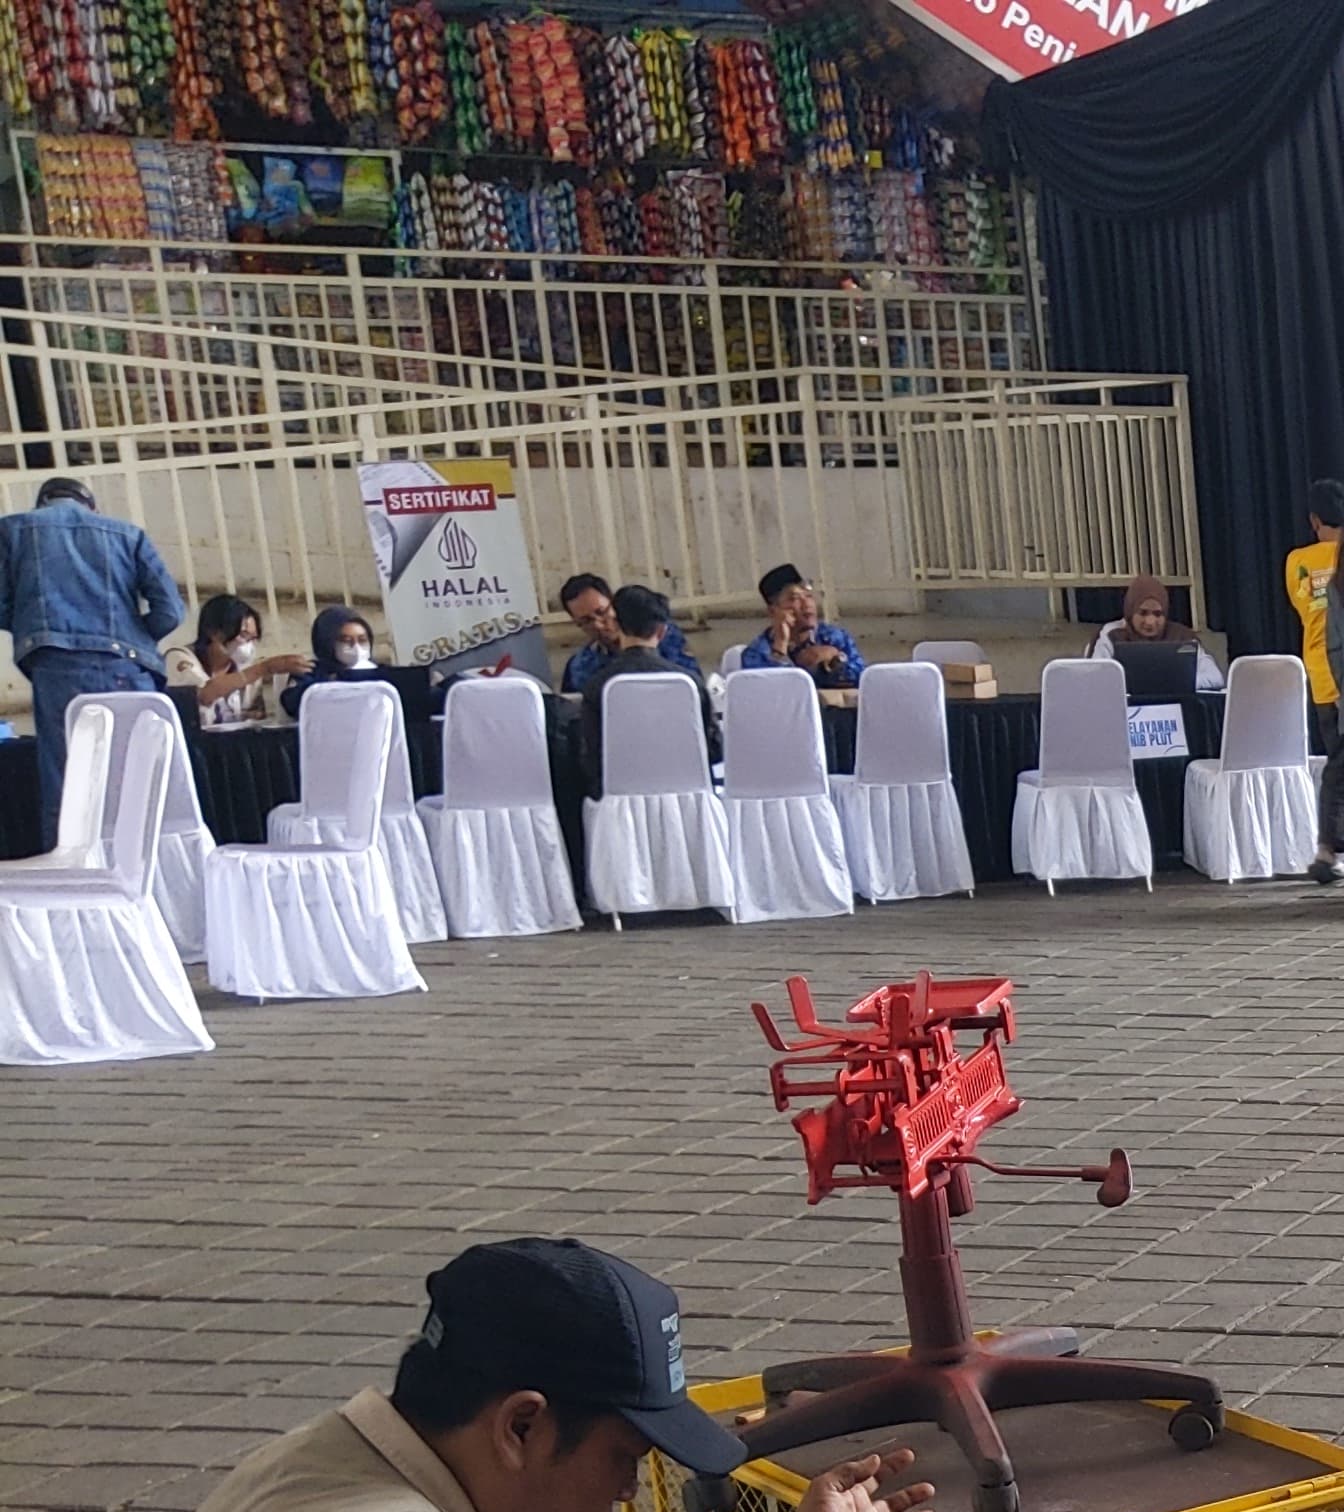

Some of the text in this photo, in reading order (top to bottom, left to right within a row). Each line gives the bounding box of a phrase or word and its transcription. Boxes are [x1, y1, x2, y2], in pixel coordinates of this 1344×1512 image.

[389, 489, 490, 510] SERTIFIKAT
[421, 575, 508, 598] HALAL
[424, 597, 512, 609] INDONESIA
[1129, 720, 1176, 734] ELAYANAN
